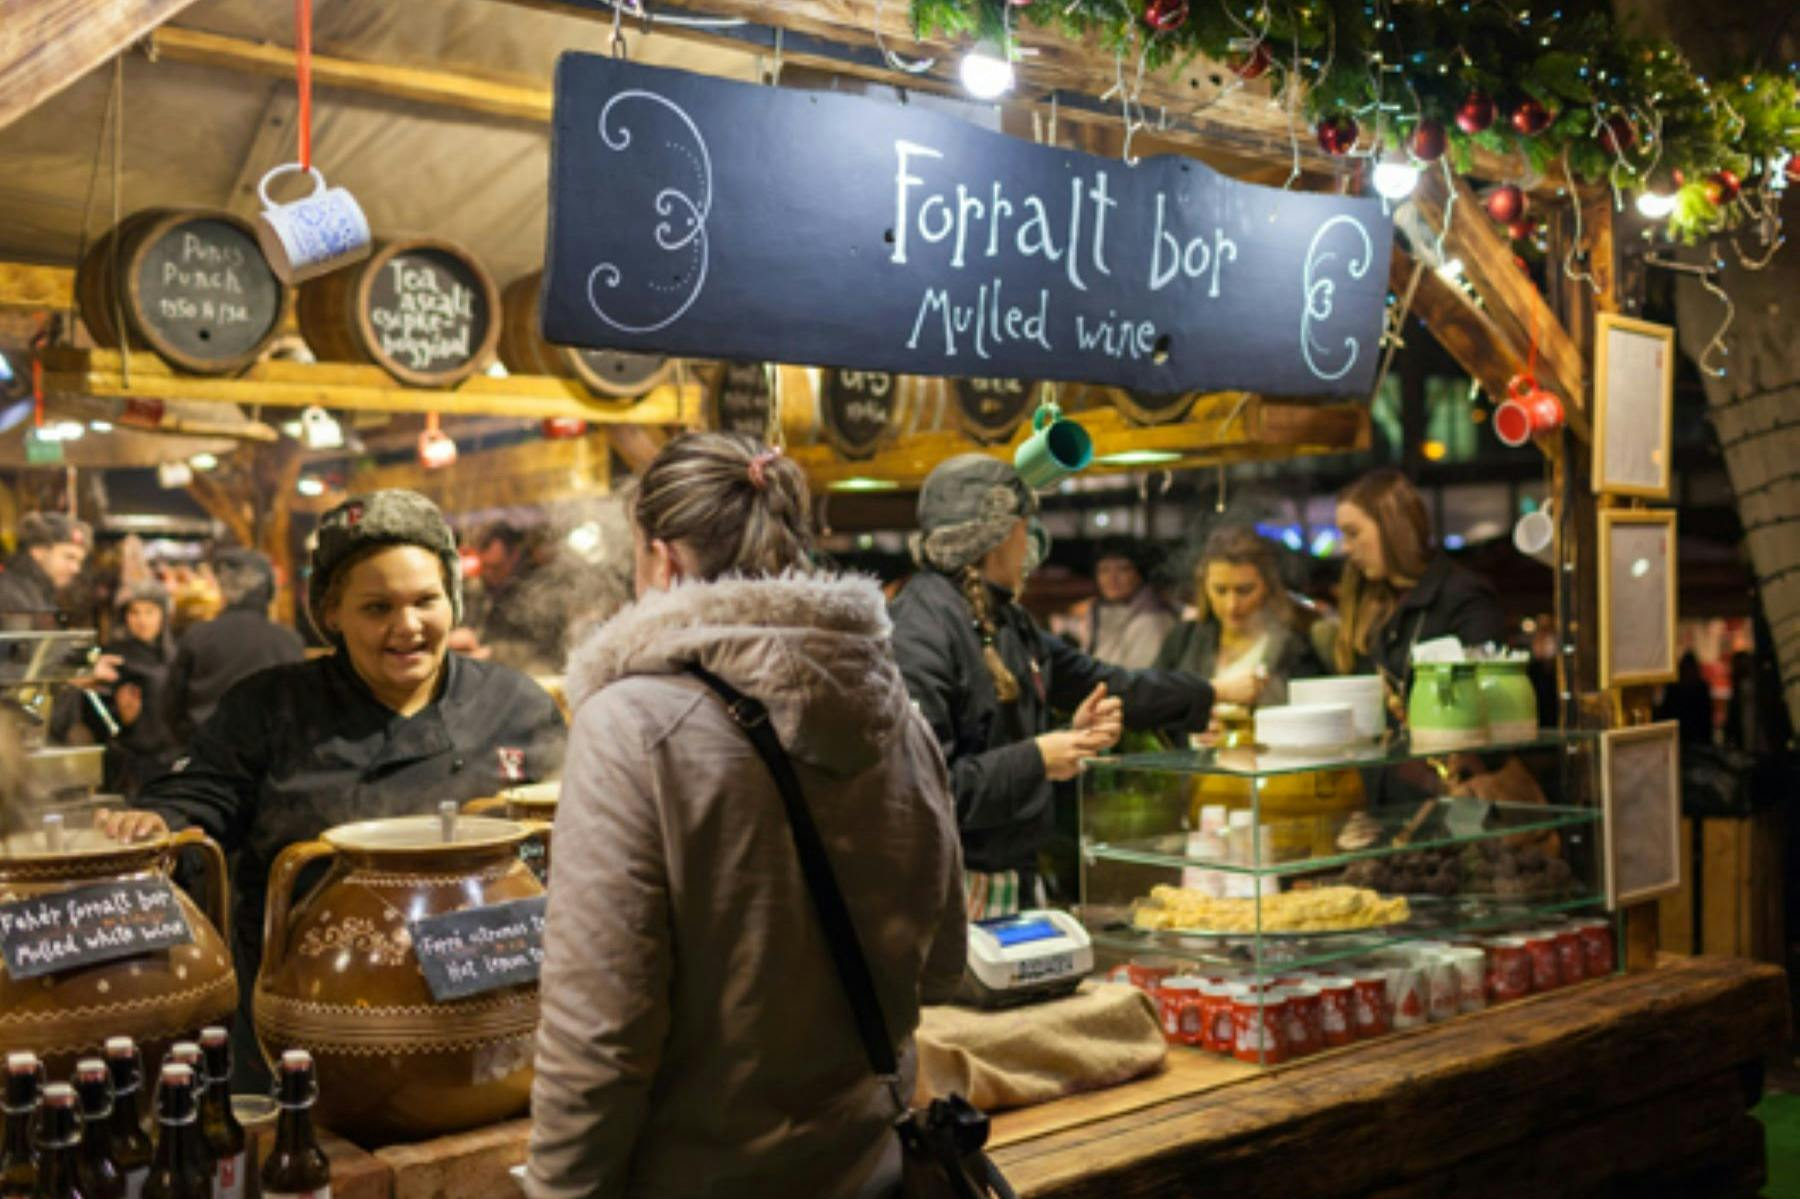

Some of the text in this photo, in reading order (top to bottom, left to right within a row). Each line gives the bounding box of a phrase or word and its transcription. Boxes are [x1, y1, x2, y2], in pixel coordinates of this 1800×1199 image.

[890, 138, 1238, 298] Forralt bor
[162, 261, 243, 295] Punch
[388, 258, 440, 294] Tea
[906, 277, 1156, 360] Mulled wine
